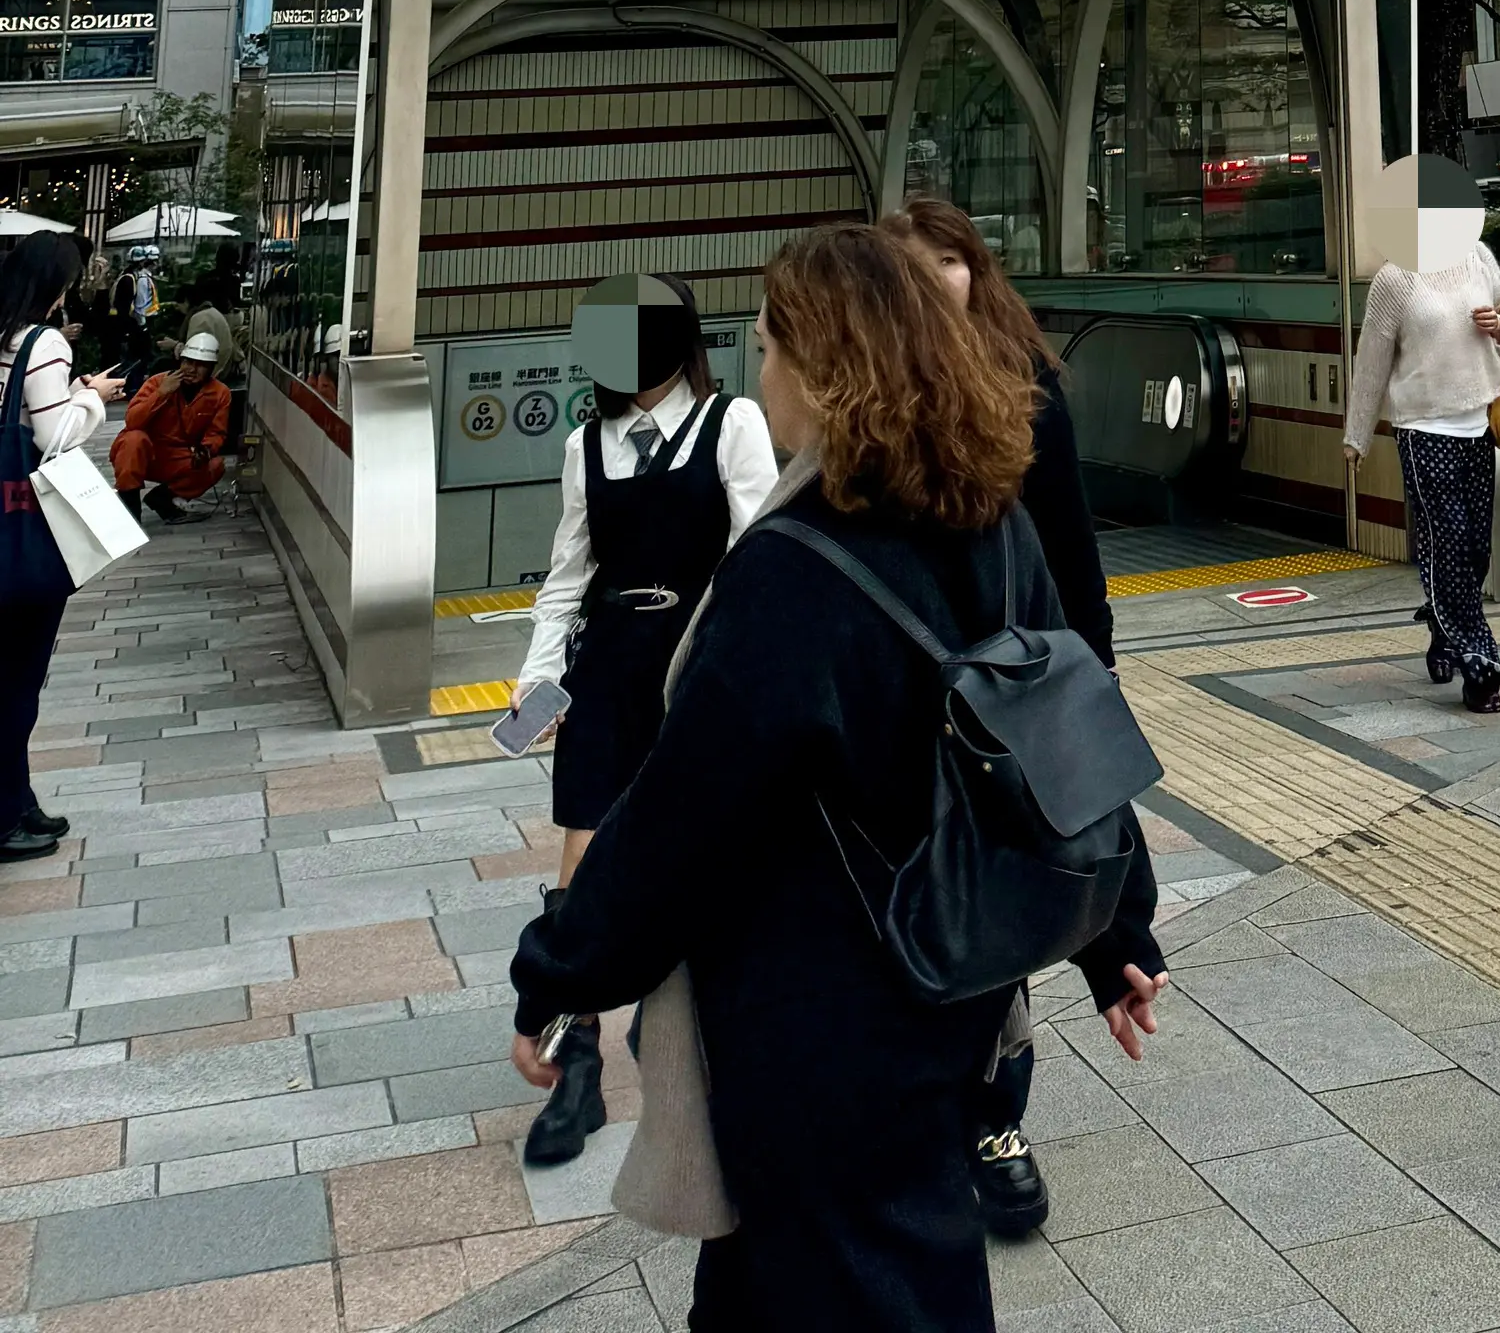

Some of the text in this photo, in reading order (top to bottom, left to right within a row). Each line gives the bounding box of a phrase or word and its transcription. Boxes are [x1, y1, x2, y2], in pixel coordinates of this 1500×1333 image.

[477, 402, 491, 415] G
[530, 398, 542, 411] Z
[472, 416, 495, 432] 02
[524, 412, 547, 427] 02
